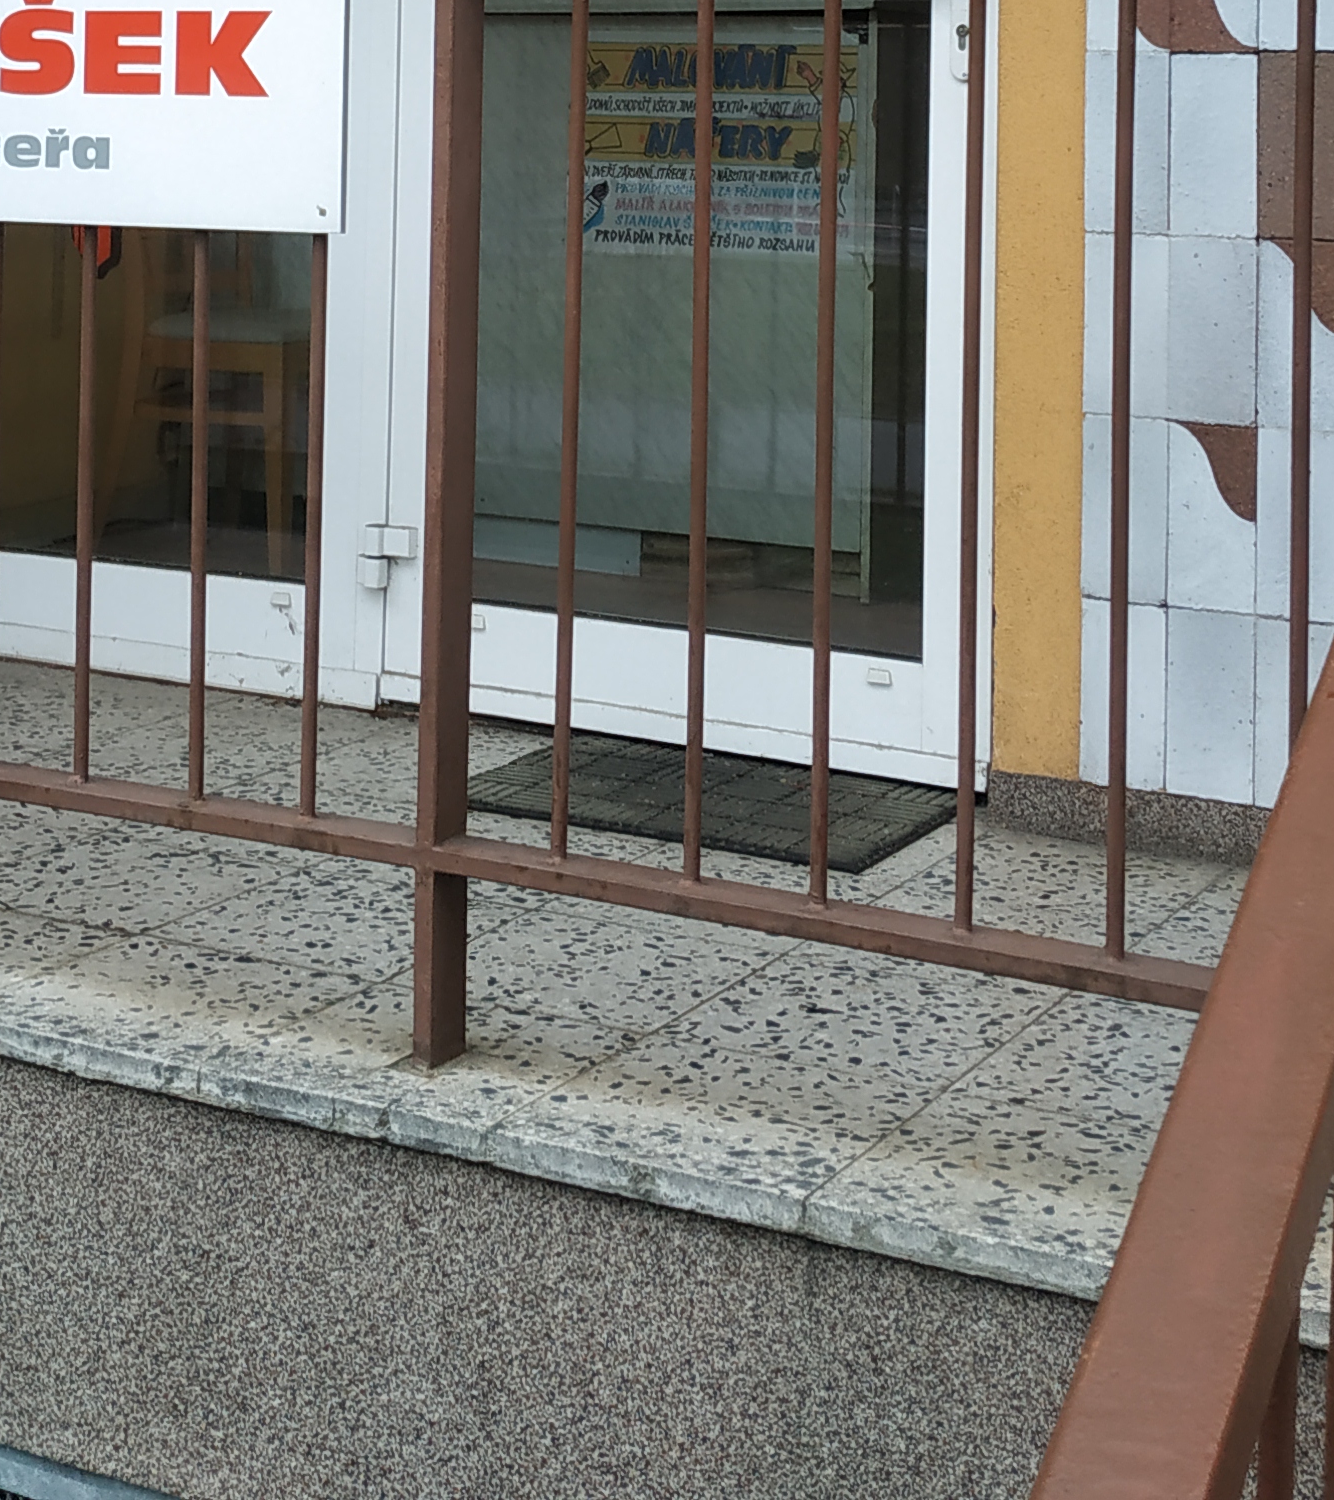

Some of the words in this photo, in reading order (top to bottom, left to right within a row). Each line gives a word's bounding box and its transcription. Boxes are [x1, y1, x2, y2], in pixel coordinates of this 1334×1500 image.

[594, 229, 655, 245] PROVÁDÍM
[658, 229, 695, 246] PRÁCE
[710, 231, 755, 249] ĚTŠÍHO
[757, 237, 816, 253] ROZSAHU
